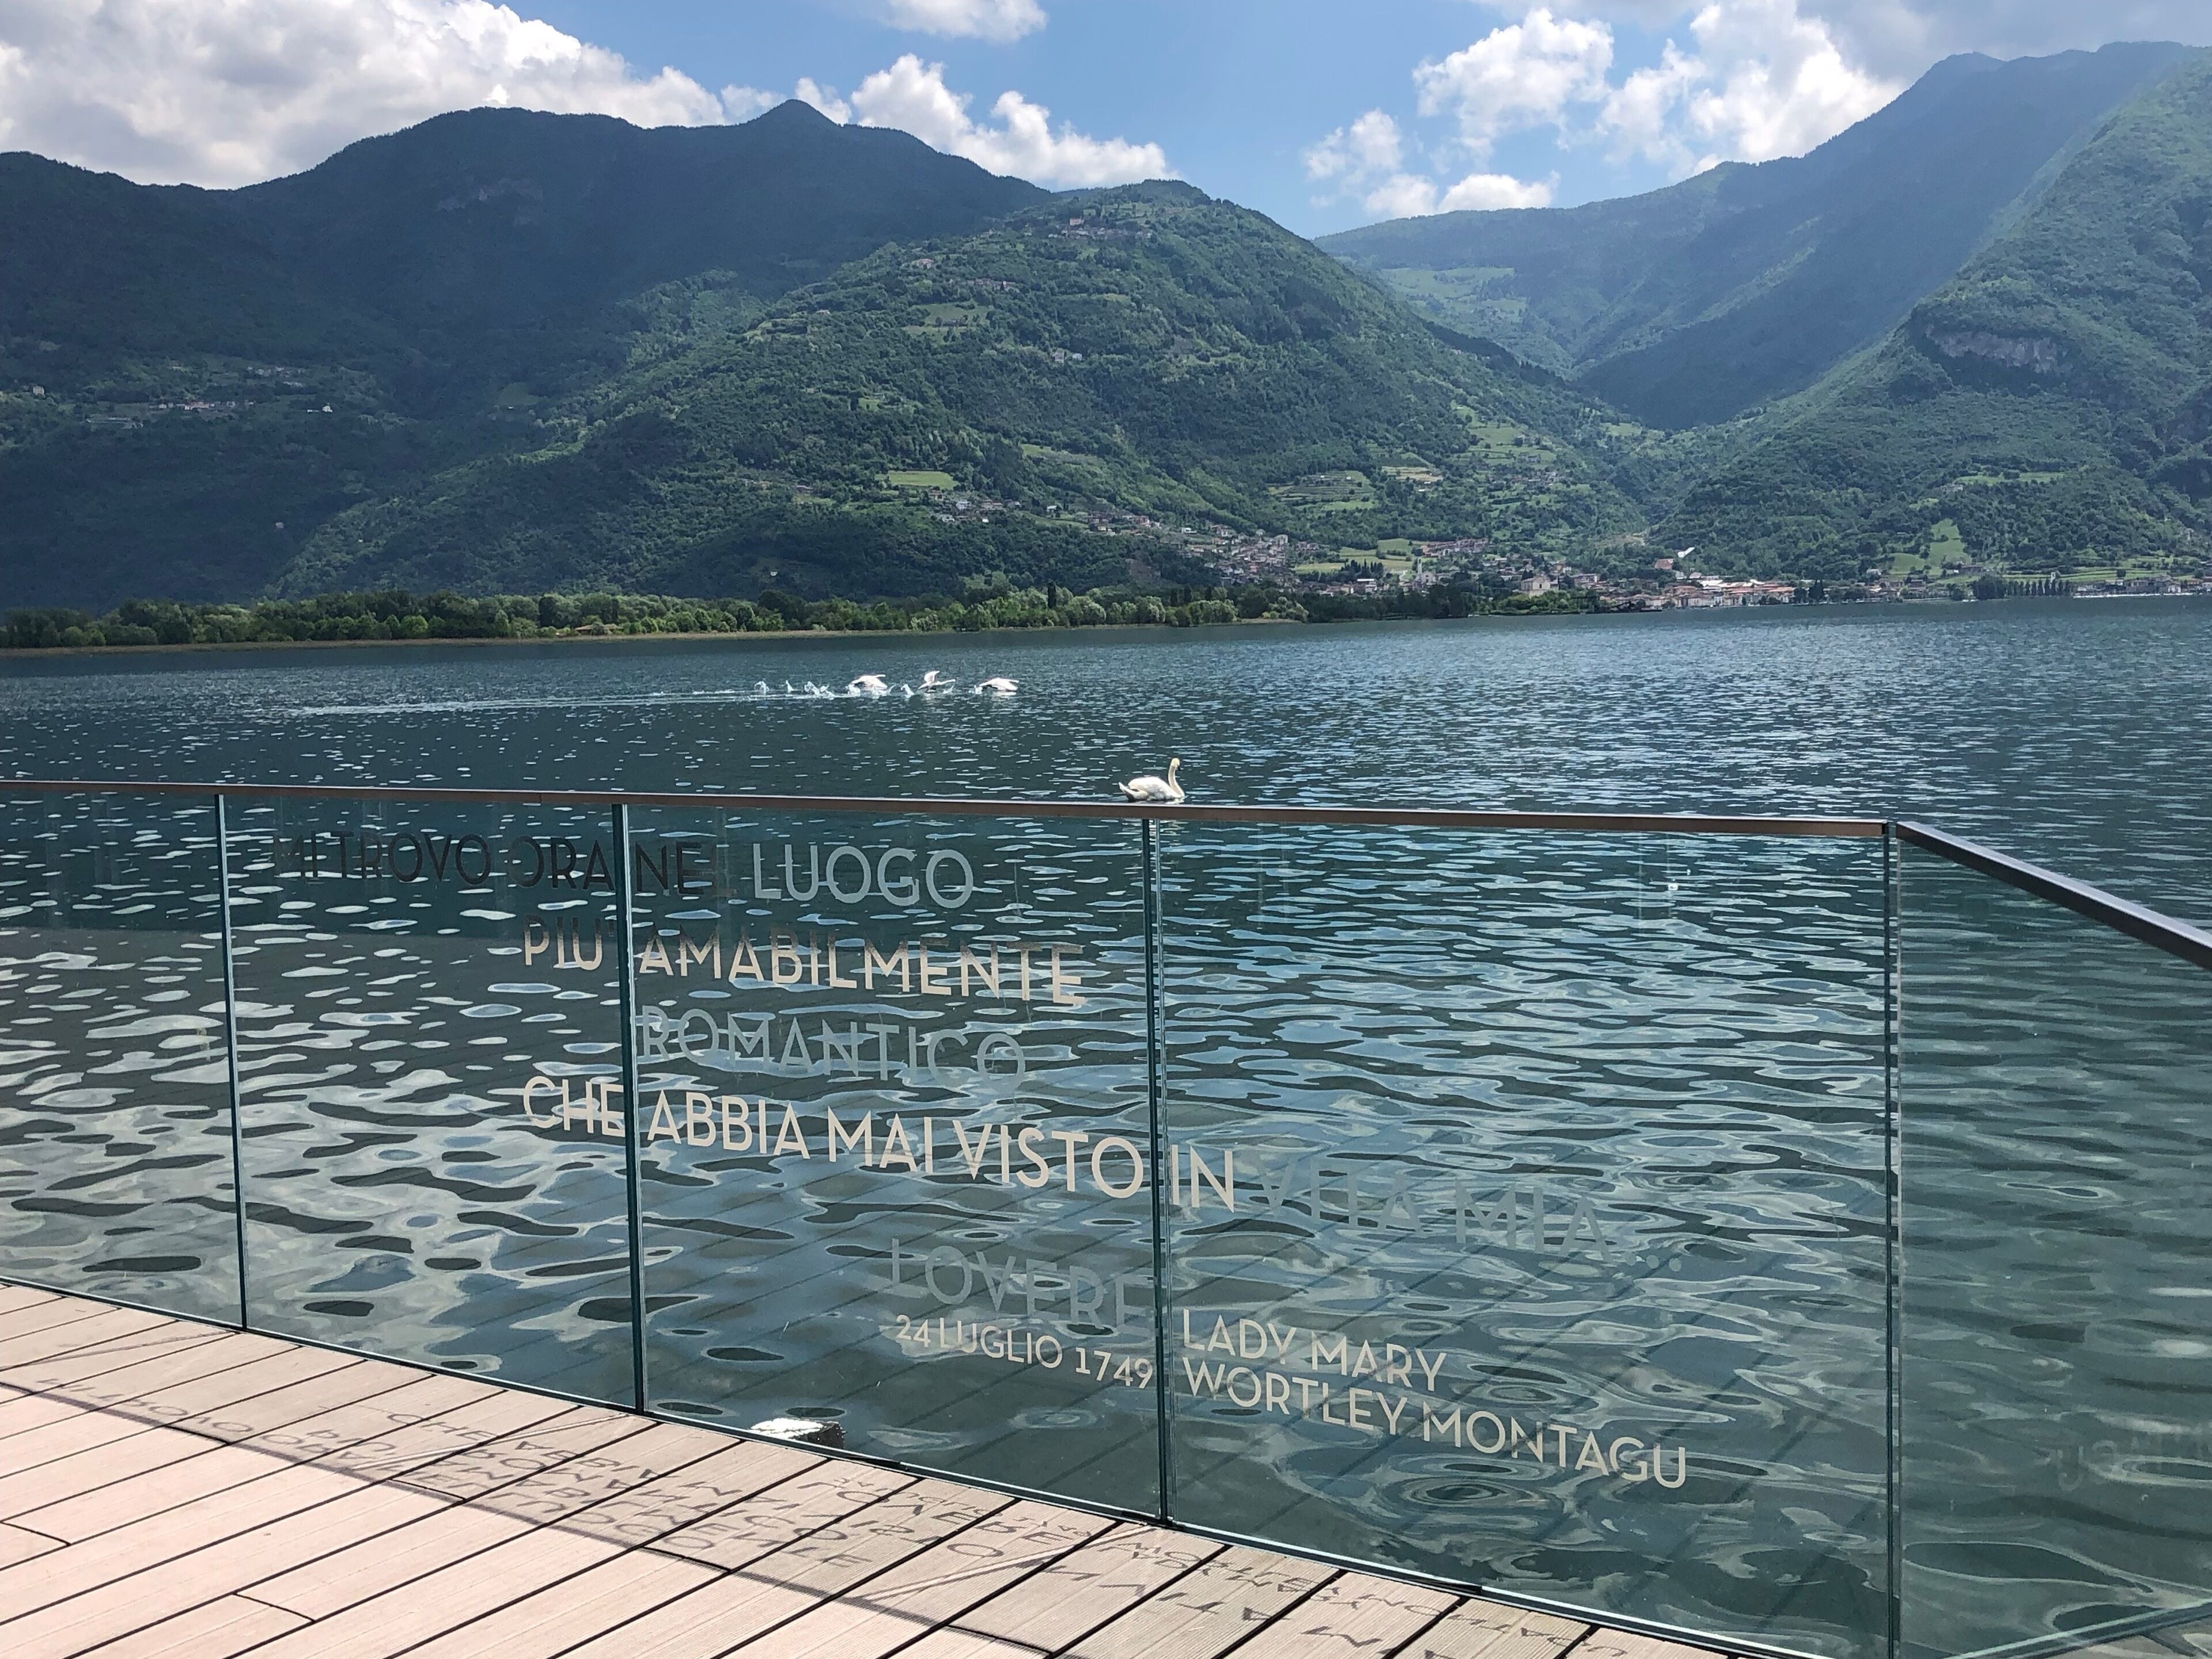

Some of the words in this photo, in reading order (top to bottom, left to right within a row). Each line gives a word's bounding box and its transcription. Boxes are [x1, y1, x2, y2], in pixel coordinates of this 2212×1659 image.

[331, 831, 491, 885] TROVO
[509, 835, 615, 891] ORA
[752, 843, 974, 908] LUOGO
[639, 922, 1085, 1006] AMABILMENTE
[641, 1005, 1025, 1094] ROMANTICO
[523, 1076, 626, 1137] CHE
[647, 1089, 810, 1160] ABBIA
[828, 1105, 933, 1174] MAI
[952, 1119, 1143, 1199] VISTO
[1170, 1144, 1234, 1213] IN
[892, 1237, 1152, 1335] LOVERE
[896, 1314, 931, 1348] 24
[940, 1317, 1063, 1369] LUGLIO
[1075, 1347, 1153, 1389] 1749
[1183, 1308, 1297, 1365] LADY
[1311, 1331, 1447, 1392] MARY
[1181, 1357, 1409, 1435] WORTLEY
[1423, 1400, 1686, 1490] MONTAGU
